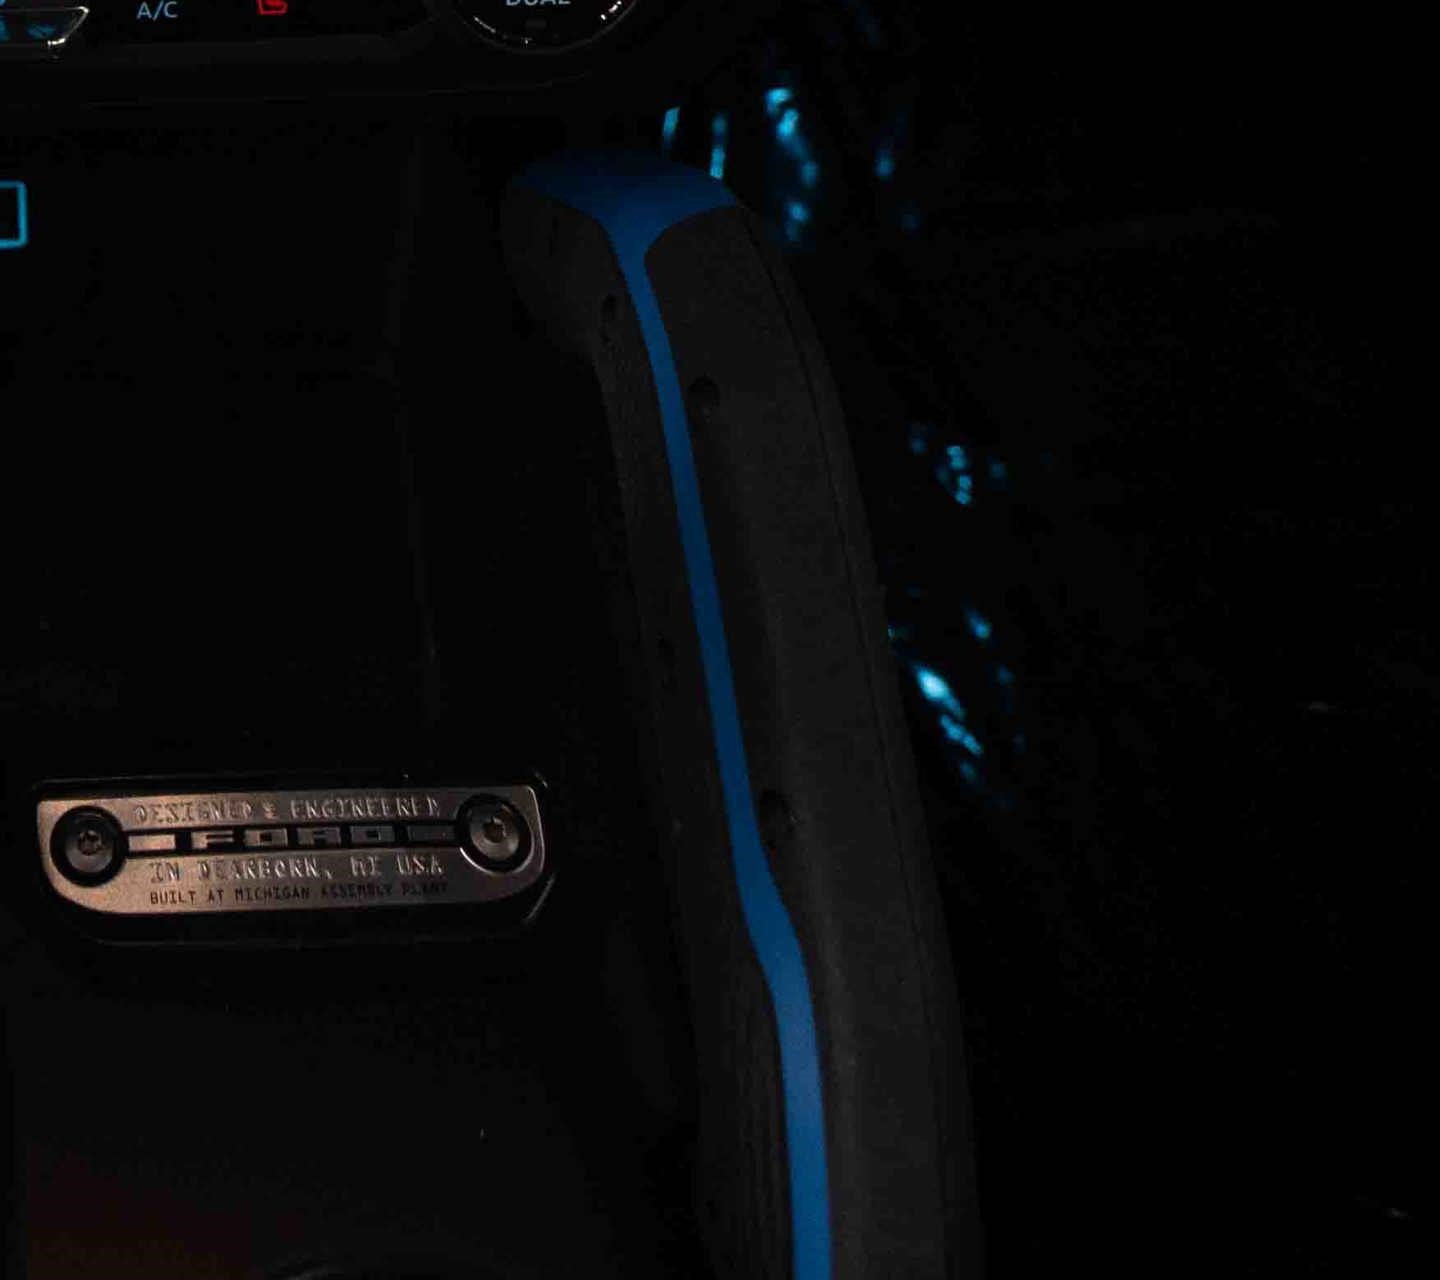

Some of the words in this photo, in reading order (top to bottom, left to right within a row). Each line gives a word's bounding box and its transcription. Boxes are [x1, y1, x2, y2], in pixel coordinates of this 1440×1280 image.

[136, 0, 178, 21] A/C
[190, 824, 397, 851] FORD
[149, 861, 181, 884] IN
[396, 853, 446, 877] USA
[149, 890, 197, 906] BUILT
[206, 889, 225, 903] AT
[234, 885, 310, 903] MICHIGAN
